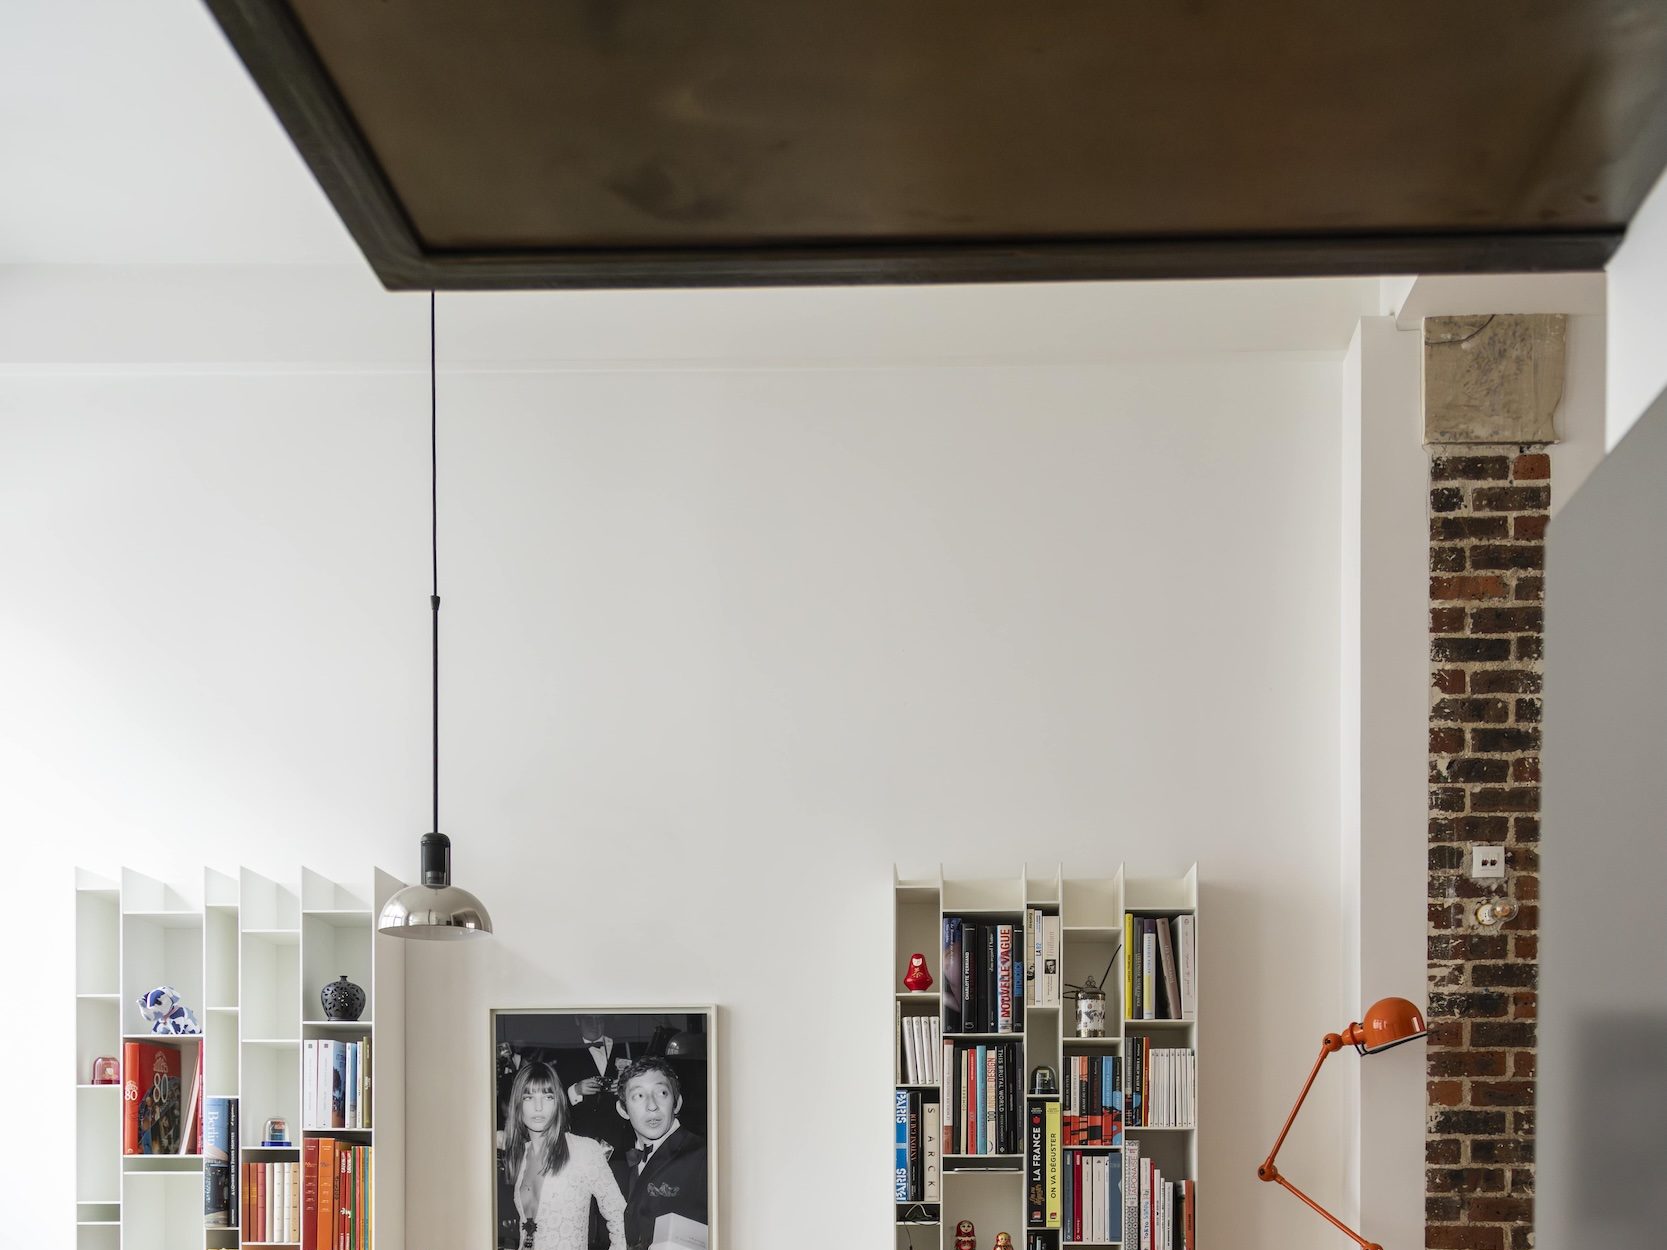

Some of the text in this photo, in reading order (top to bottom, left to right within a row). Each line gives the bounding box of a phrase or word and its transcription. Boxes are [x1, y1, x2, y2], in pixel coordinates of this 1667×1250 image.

[1000, 929, 1011, 1018] NOUVELLE VAGUE
[987, 1057, 996, 1083] DESIGN
[125, 1089, 138, 1101] 80
[153, 1072, 169, 1103] 80
[896, 1091, 907, 1124] PARIS
[207, 1111, 220, 1146] Berlin
[927, 1107, 936, 1187] SARCK
[1033, 1127, 1041, 1167] FRANCE
[1033, 1167, 1041, 1181] LA
[1048, 1133, 1057, 1199] ON VA DÉGUSTER
[896, 1168, 907, 1201] PARIS
